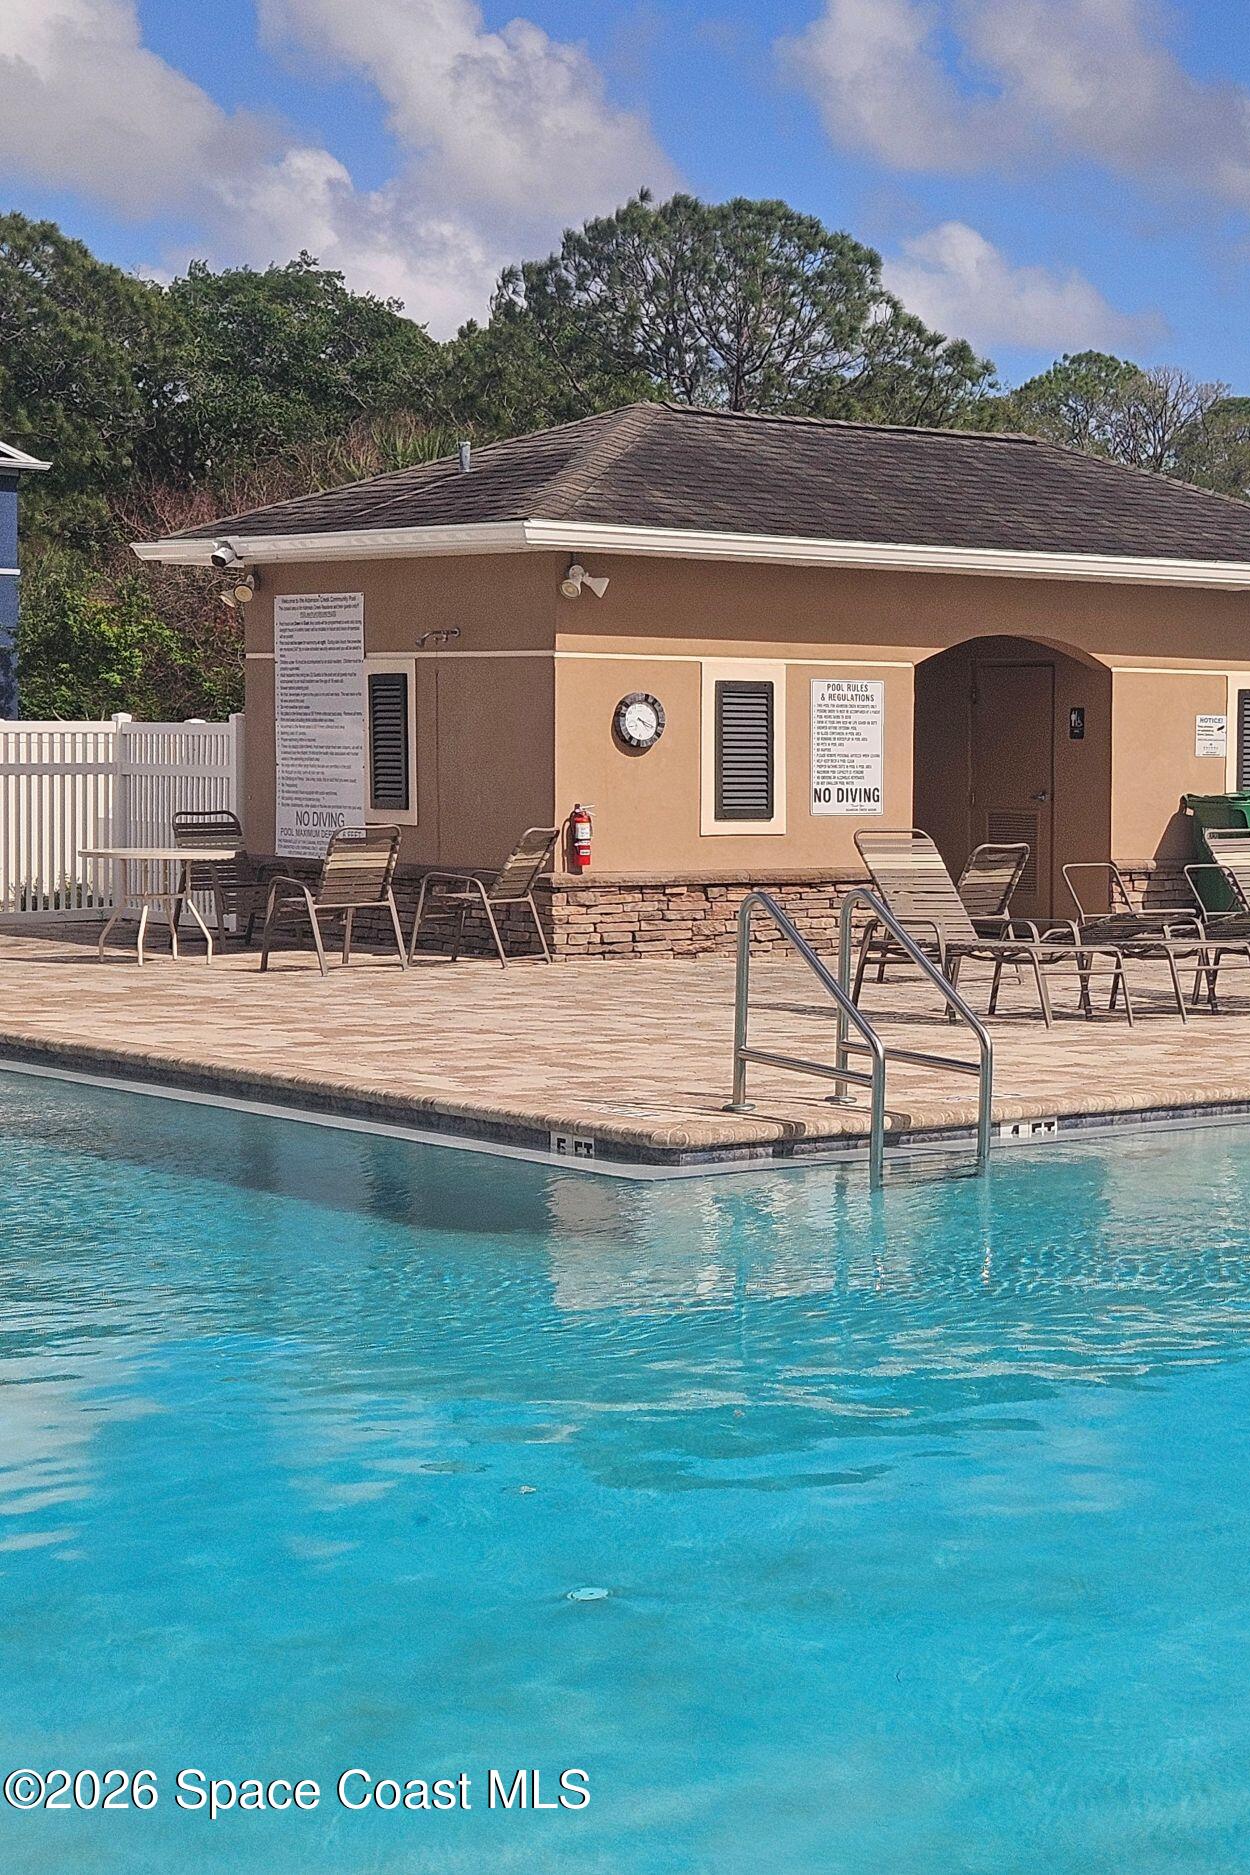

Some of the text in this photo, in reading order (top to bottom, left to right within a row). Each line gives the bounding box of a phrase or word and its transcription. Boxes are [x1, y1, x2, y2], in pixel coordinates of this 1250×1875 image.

[827, 683, 869, 692] POOL RULES
[820, 693, 875, 702] & REGULATIONS
[813, 787, 880, 803] NO DIVING
[295, 811, 345, 828] NO DIVING
[280, 827, 294, 837] POOL
[295, 829, 320, 838] MAXIMUM
